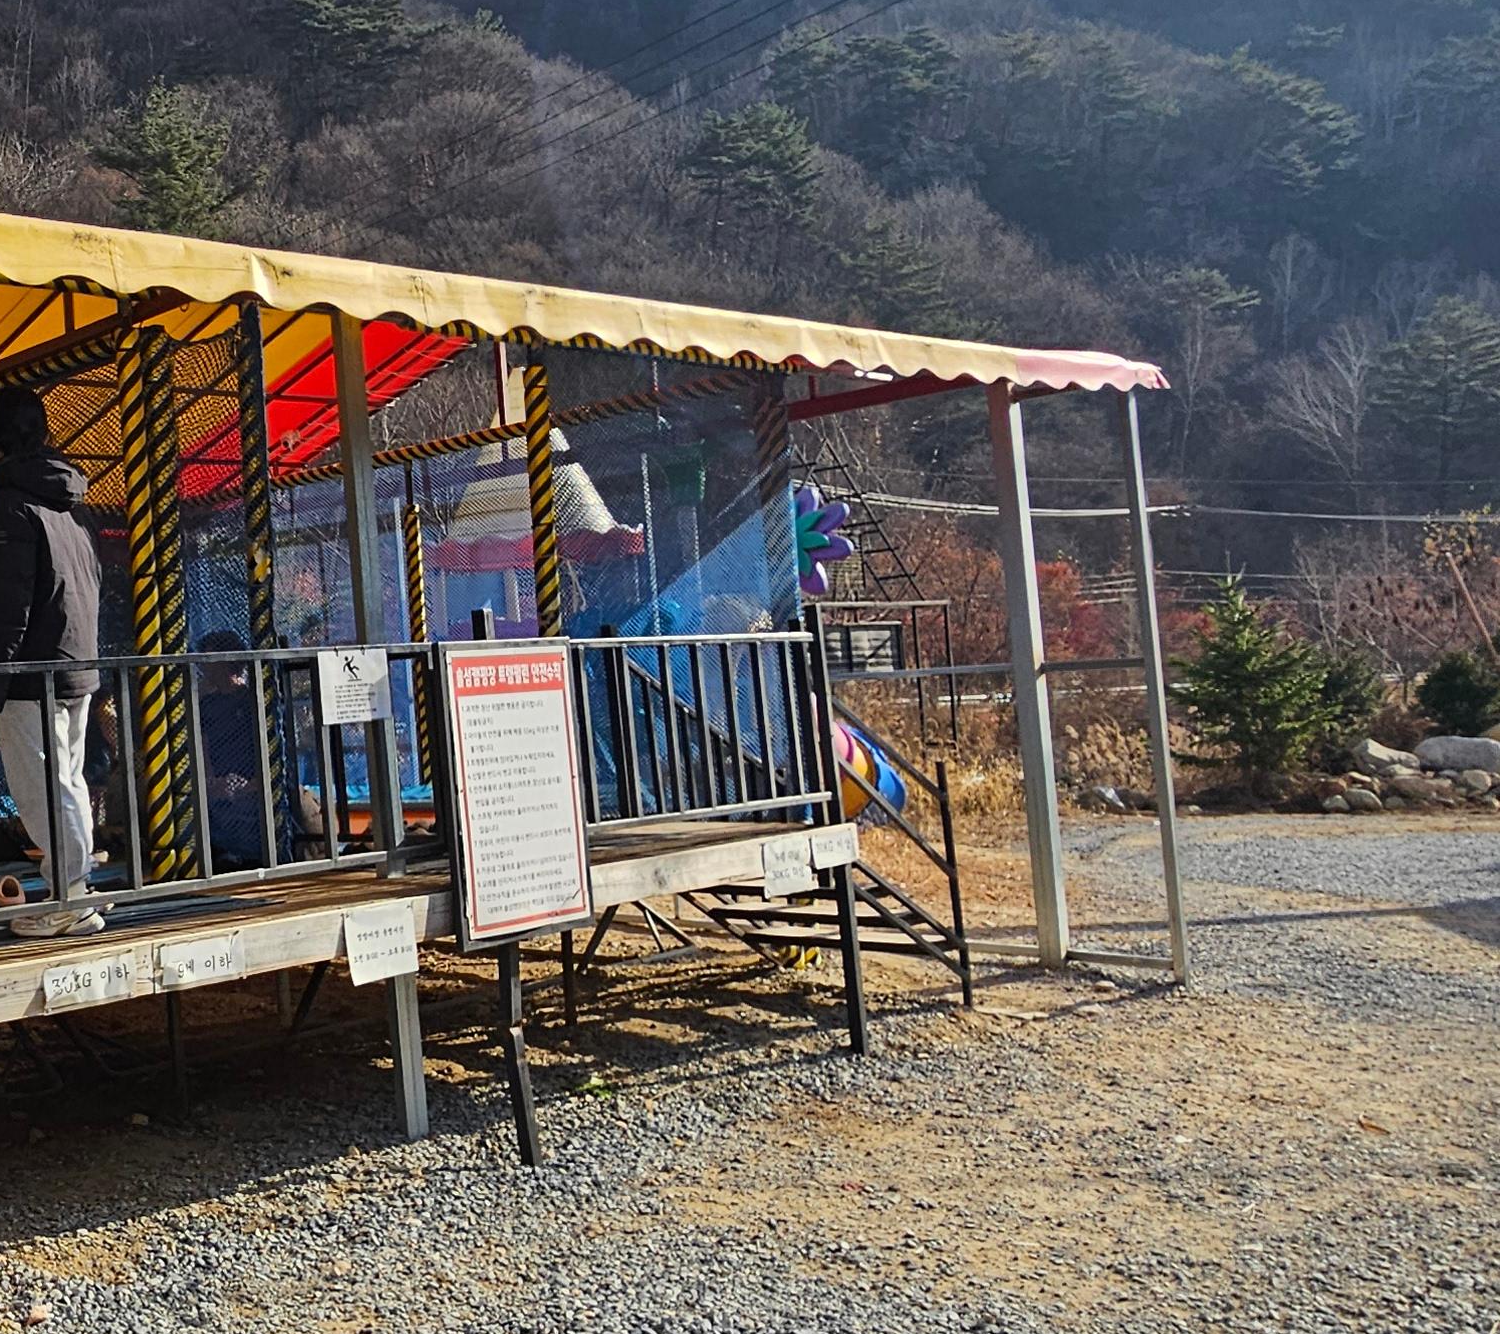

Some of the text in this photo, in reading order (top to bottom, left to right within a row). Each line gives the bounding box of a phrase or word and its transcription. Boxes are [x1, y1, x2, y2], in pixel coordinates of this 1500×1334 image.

[530, 661, 562, 683] 안전수칙
[205, 953, 232, 971] 이하
[100, 963, 130, 985] 이하
